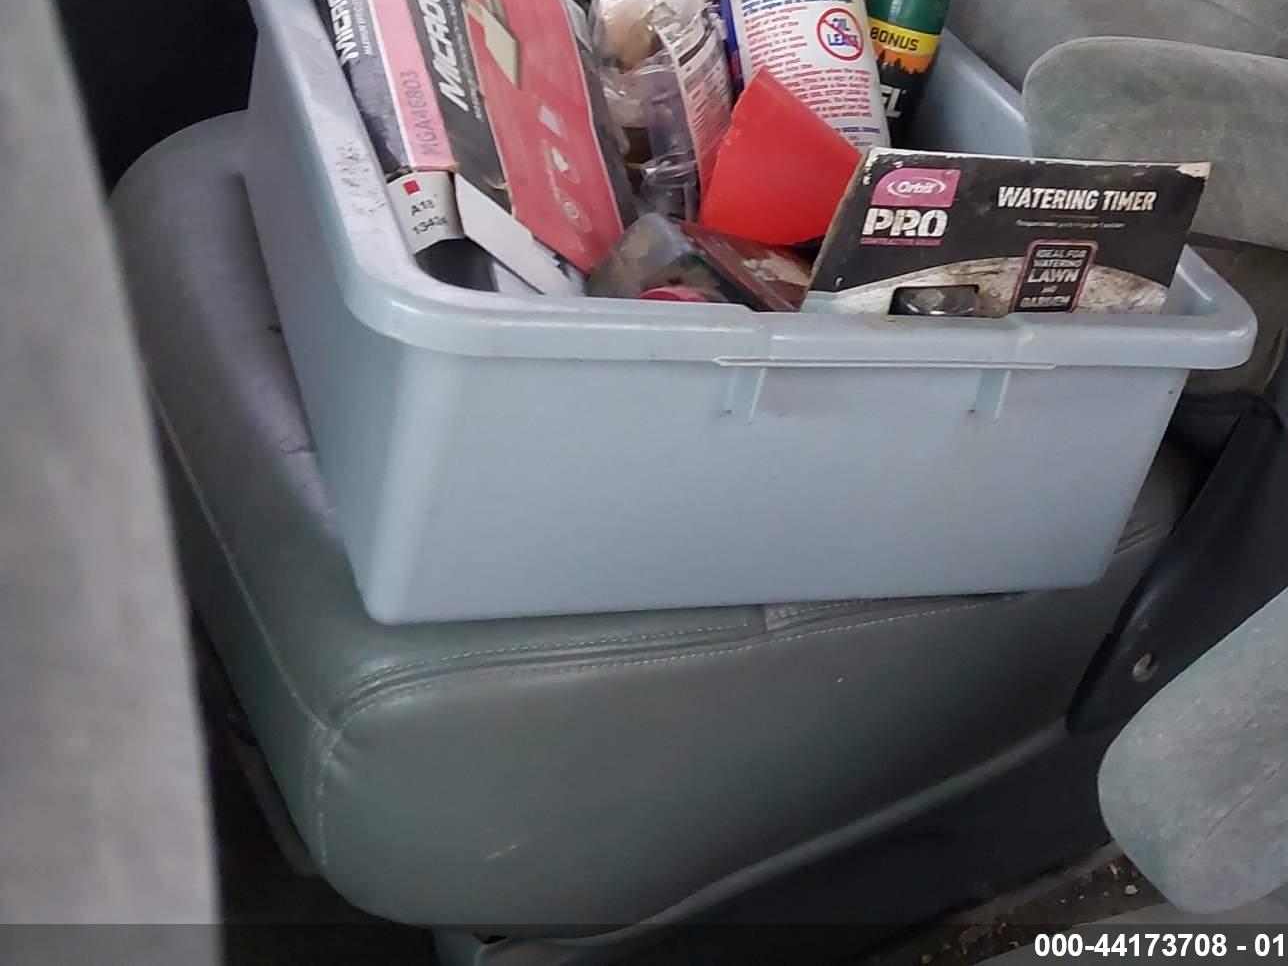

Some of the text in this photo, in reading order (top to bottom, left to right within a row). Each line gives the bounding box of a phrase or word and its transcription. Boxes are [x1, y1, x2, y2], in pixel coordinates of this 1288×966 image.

[870, 26, 919, 51] BONUS
[897, 180, 937, 193] Orbit
[998, 186, 1157, 212] WATERING TIMER
[861, 208, 948, 237] PRO
[1027, 268, 1080, 283] LAWN
